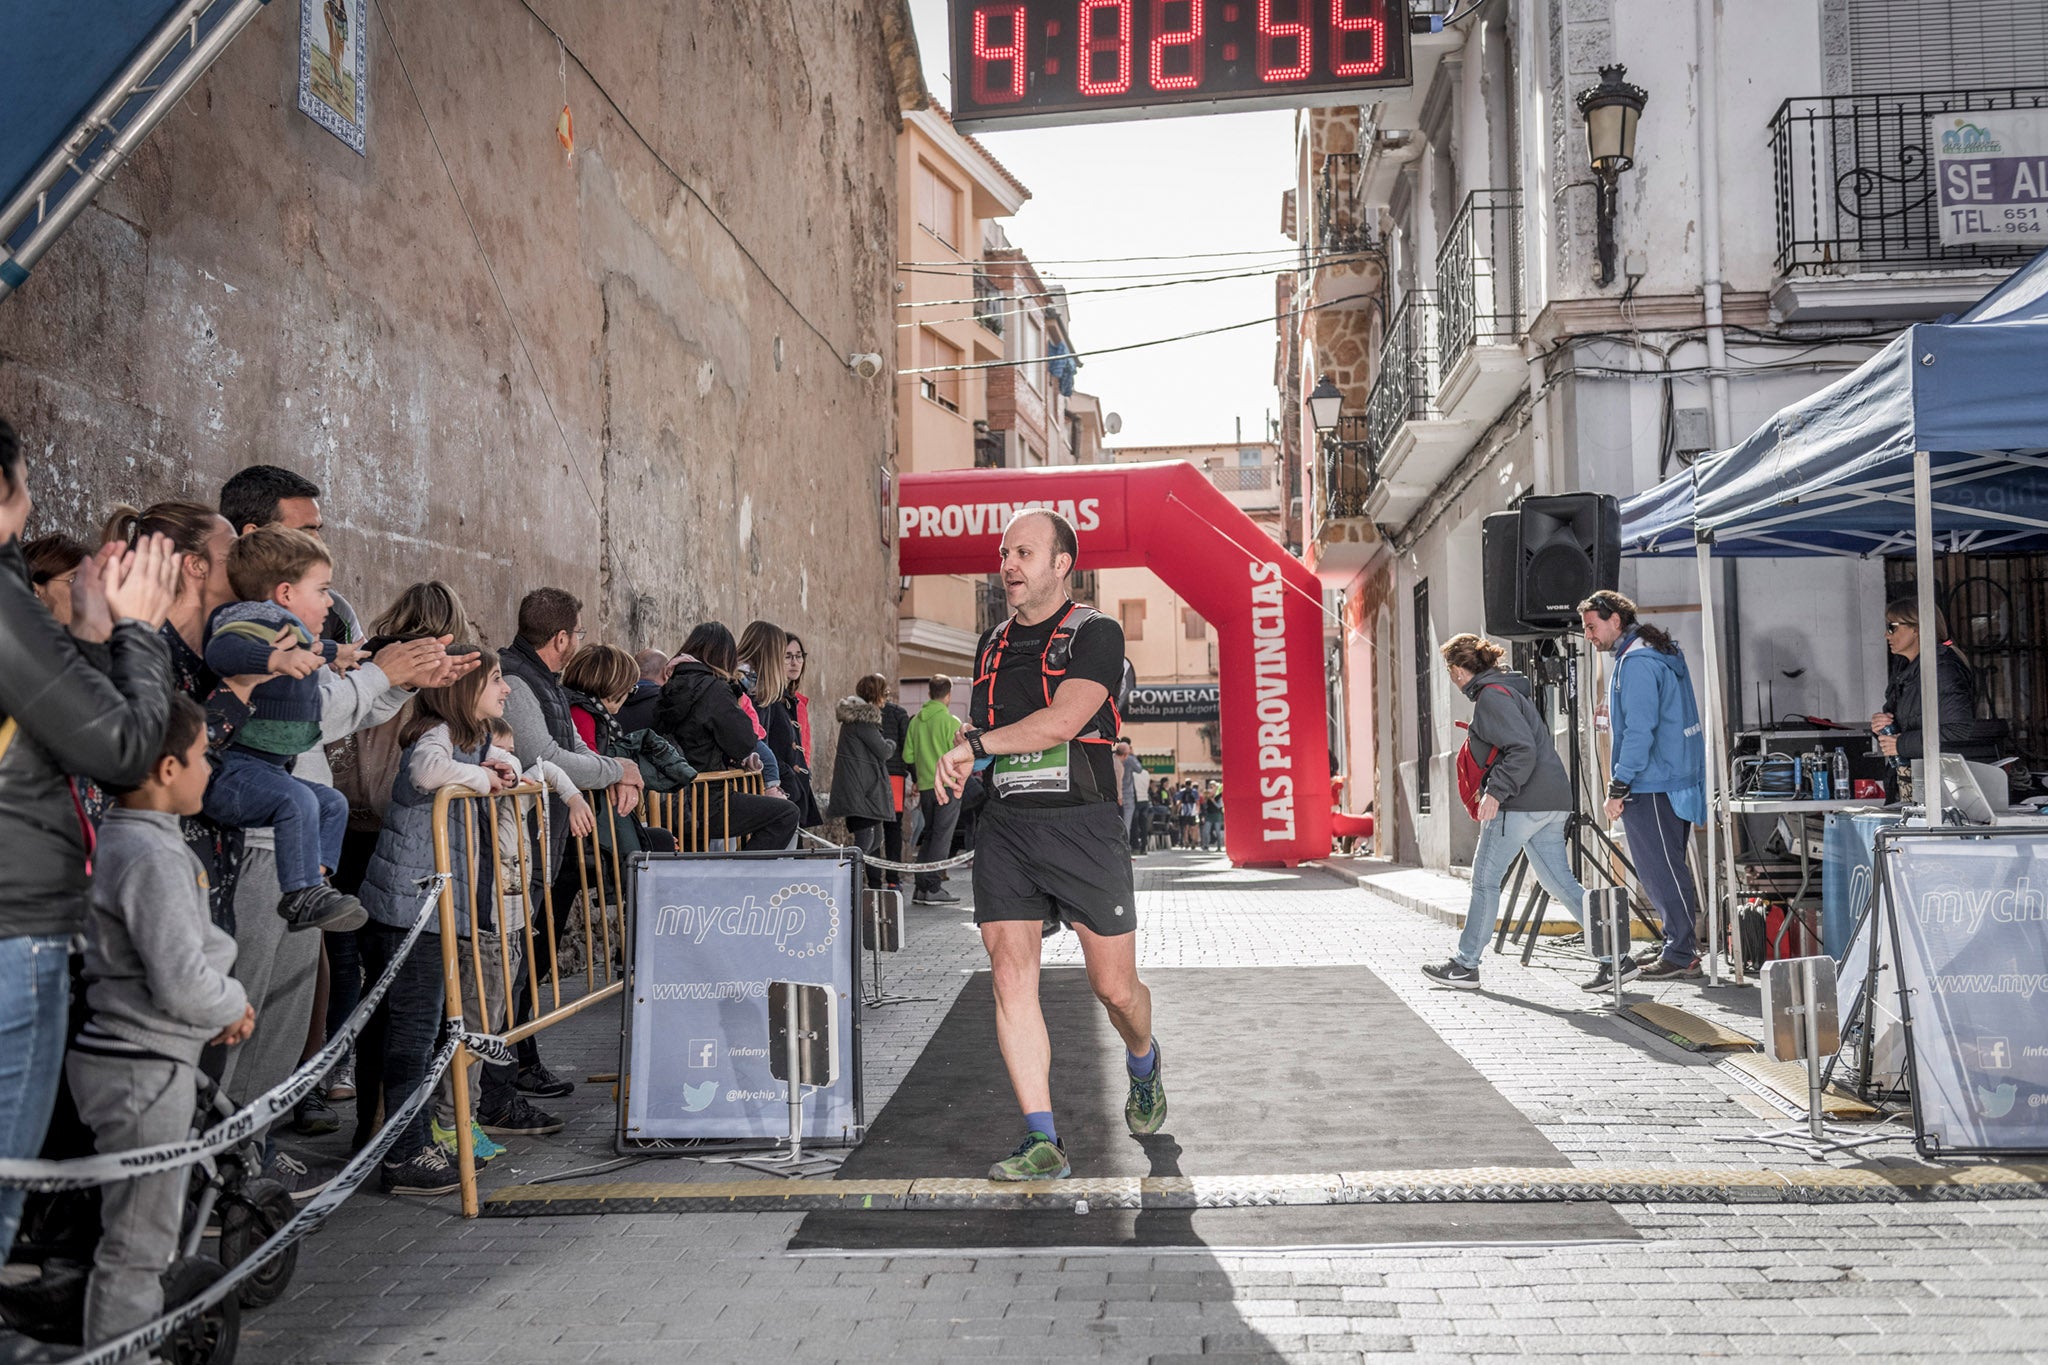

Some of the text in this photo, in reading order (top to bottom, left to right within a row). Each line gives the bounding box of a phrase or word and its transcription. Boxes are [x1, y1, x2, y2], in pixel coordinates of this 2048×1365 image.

[1947, 160, 2048, 201] SE AL
[2004, 207, 2038, 219] 651
[2004, 222, 2041, 233] 964
[899, 498, 1099, 538] PROVINAS
[1128, 704, 1160, 715] bebida
[1162, 705, 1184, 717] para
[1249, 561, 1296, 842] LAS PROVINCIAS
[655, 894, 806, 945] mychip
[727, 1046, 770, 1058] /infomy
